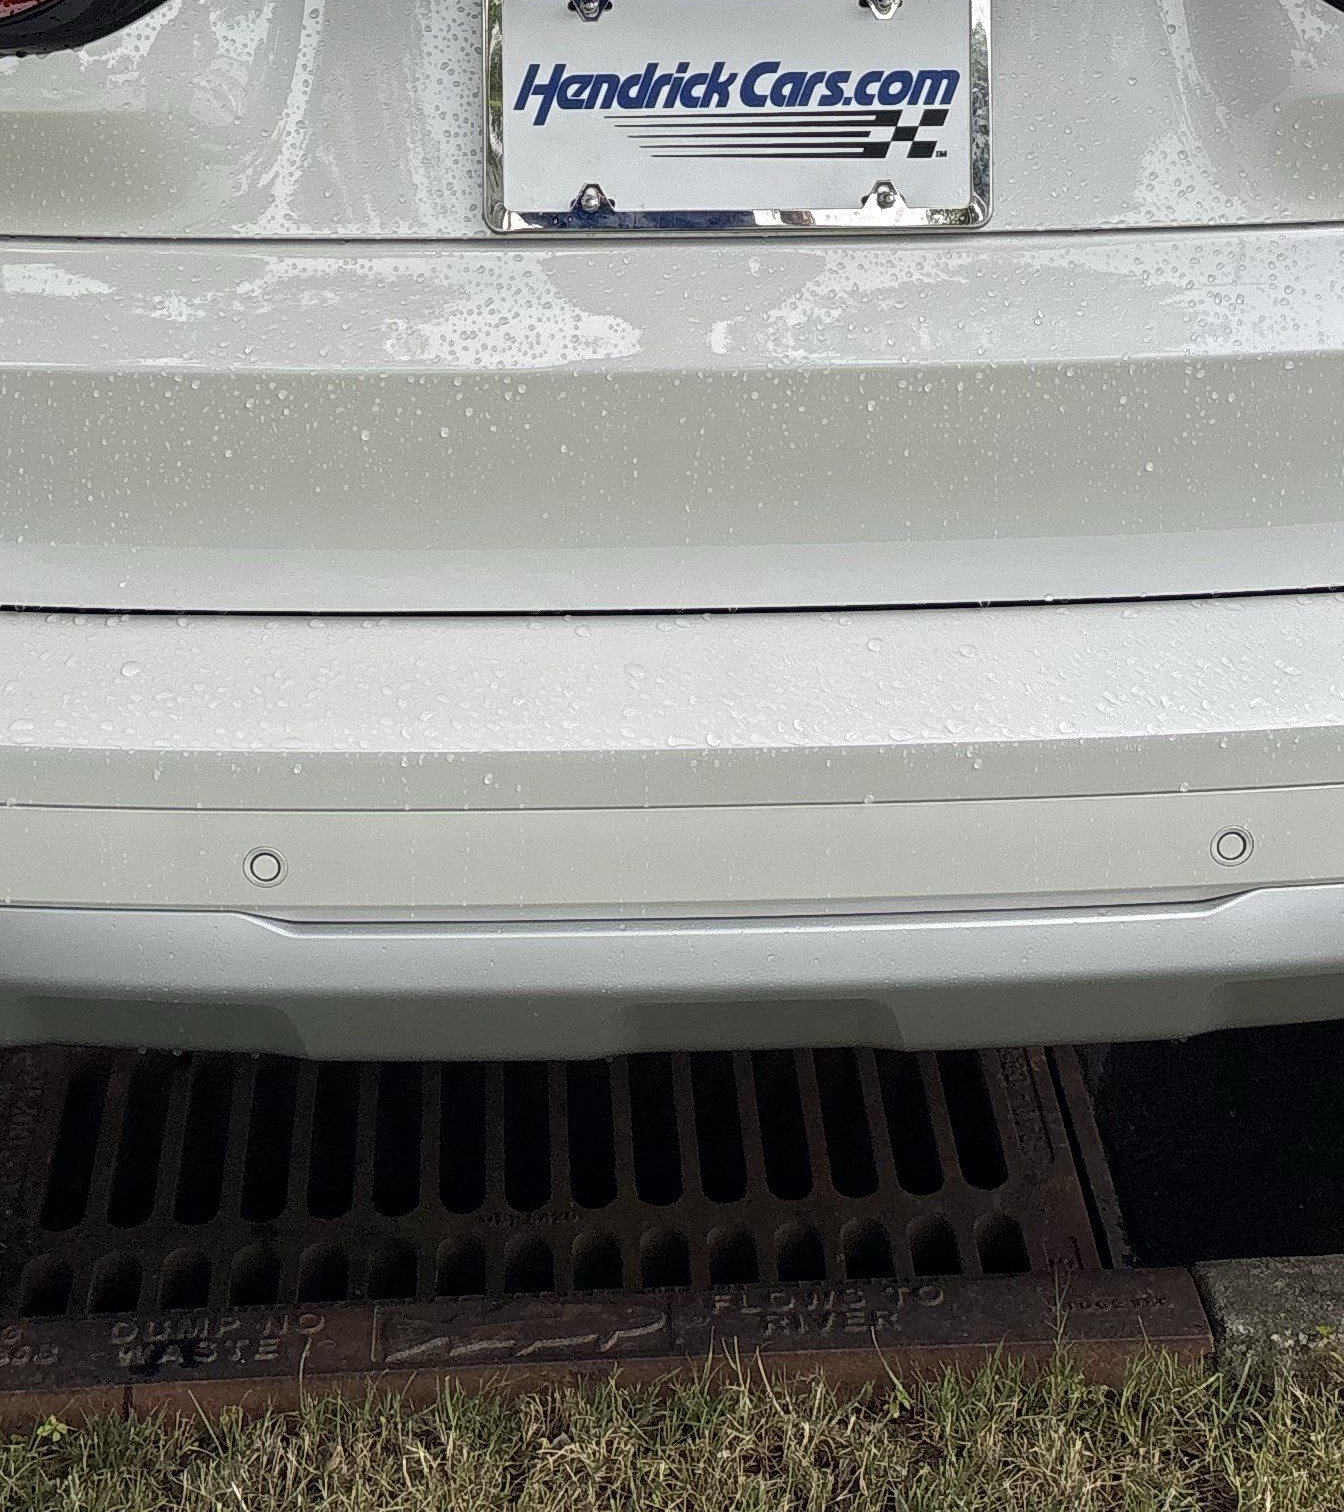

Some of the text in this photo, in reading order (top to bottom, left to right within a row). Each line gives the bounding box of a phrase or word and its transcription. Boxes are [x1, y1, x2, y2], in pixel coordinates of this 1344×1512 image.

[712, 1285, 944, 1315] FLOWS TO
[109, 1313, 326, 1345] DUMP NO
[763, 1311, 903, 1338] RIVER
[118, 1338, 281, 1367] WASTE
